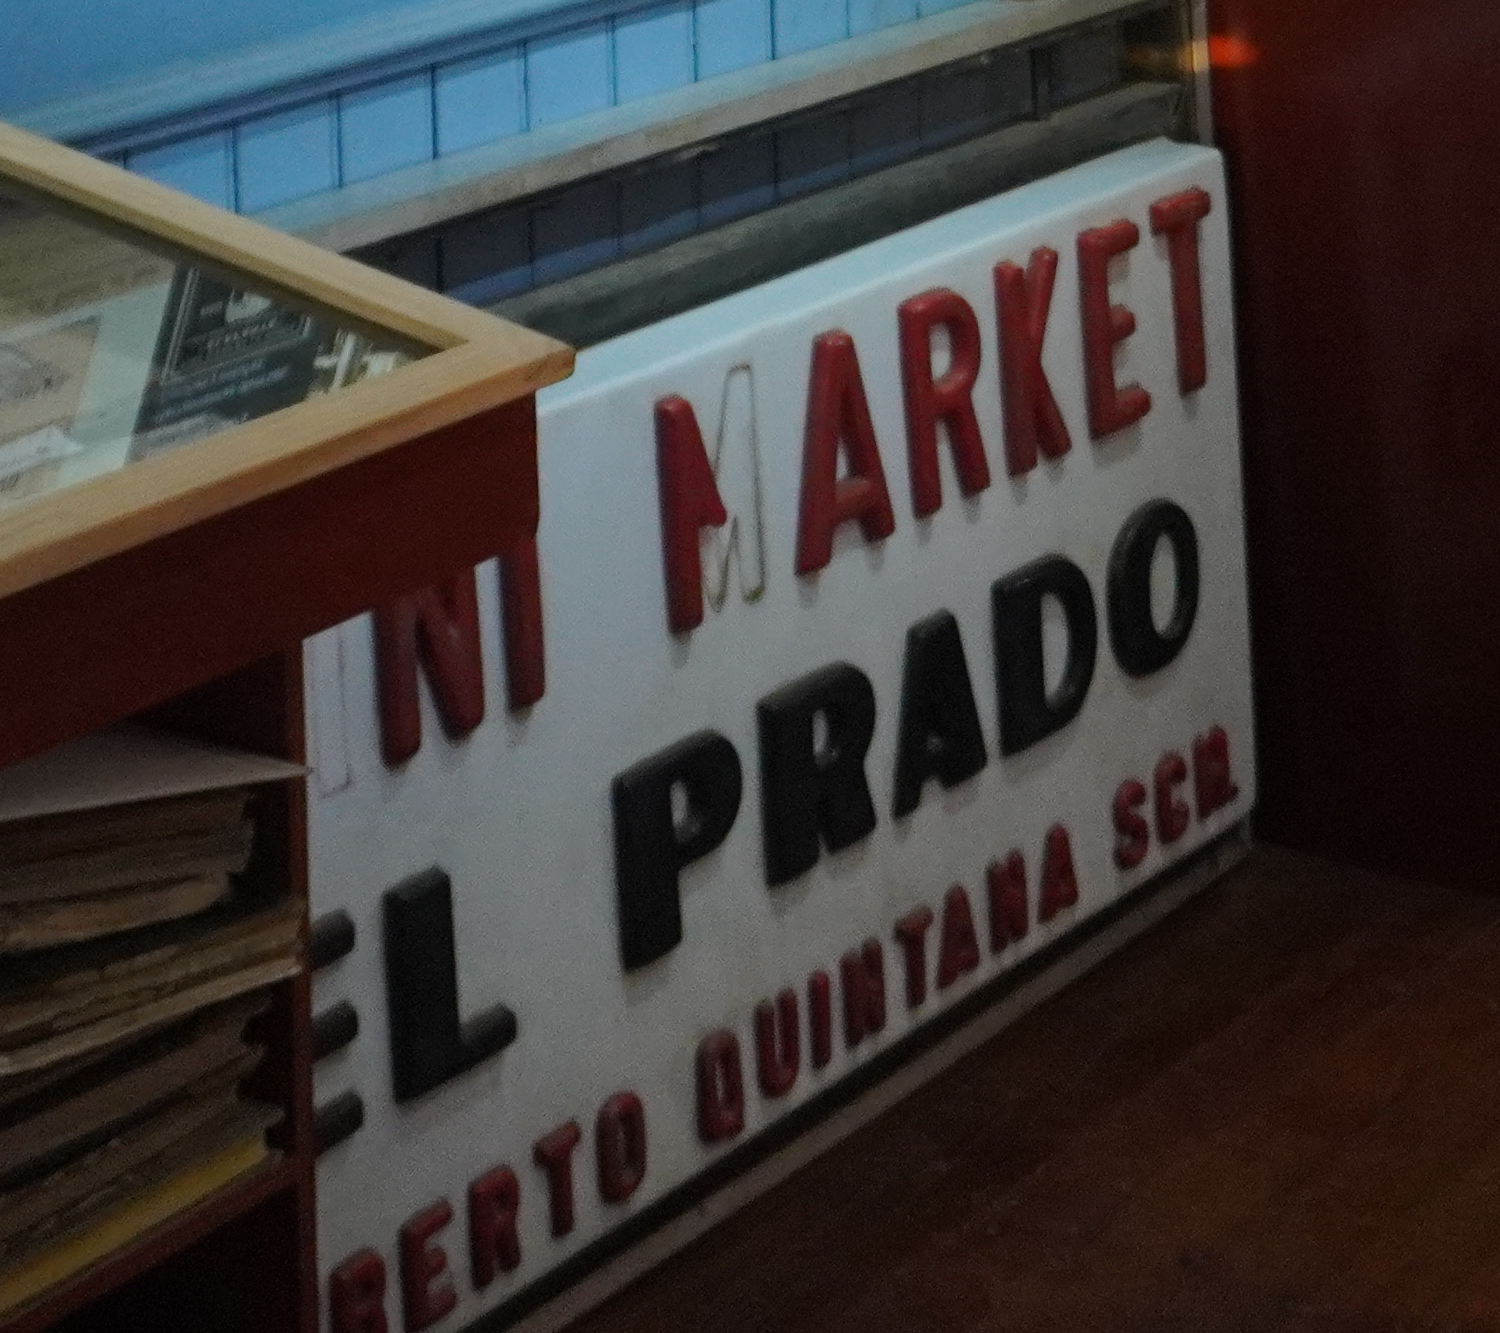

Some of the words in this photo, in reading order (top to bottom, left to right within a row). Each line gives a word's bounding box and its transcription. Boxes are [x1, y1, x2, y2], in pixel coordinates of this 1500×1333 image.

[654, 185, 1213, 635] MARKET
[610, 495, 1202, 975] PRADO
[695, 820, 1081, 1147] QUINTANA
